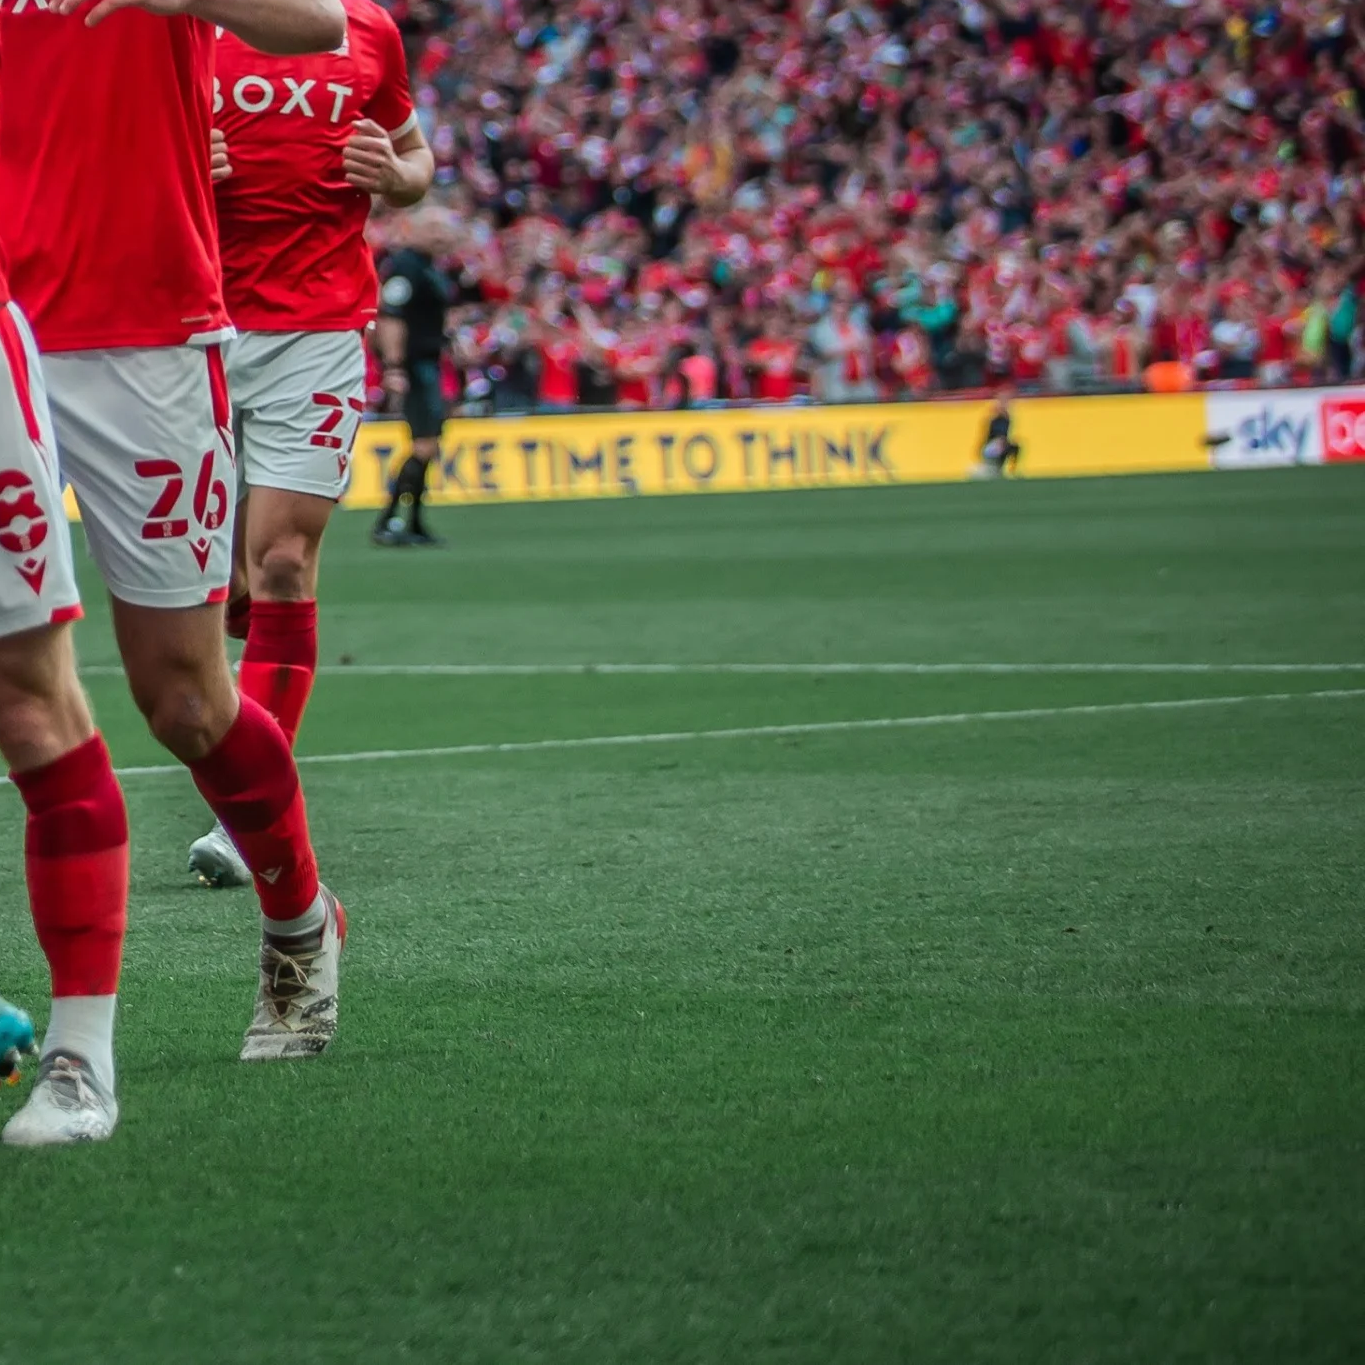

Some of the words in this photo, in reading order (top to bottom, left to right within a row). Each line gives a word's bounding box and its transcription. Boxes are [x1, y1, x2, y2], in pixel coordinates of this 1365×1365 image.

[373, 440, 498, 497] TKE
[520, 437, 636, 493] TIME
[660, 433, 720, 487] TO
[741, 425, 894, 485] THINK
[1238, 408, 1310, 465] sky
[1327, 402, 1365, 457] be
[133, 450, 229, 540] 26
